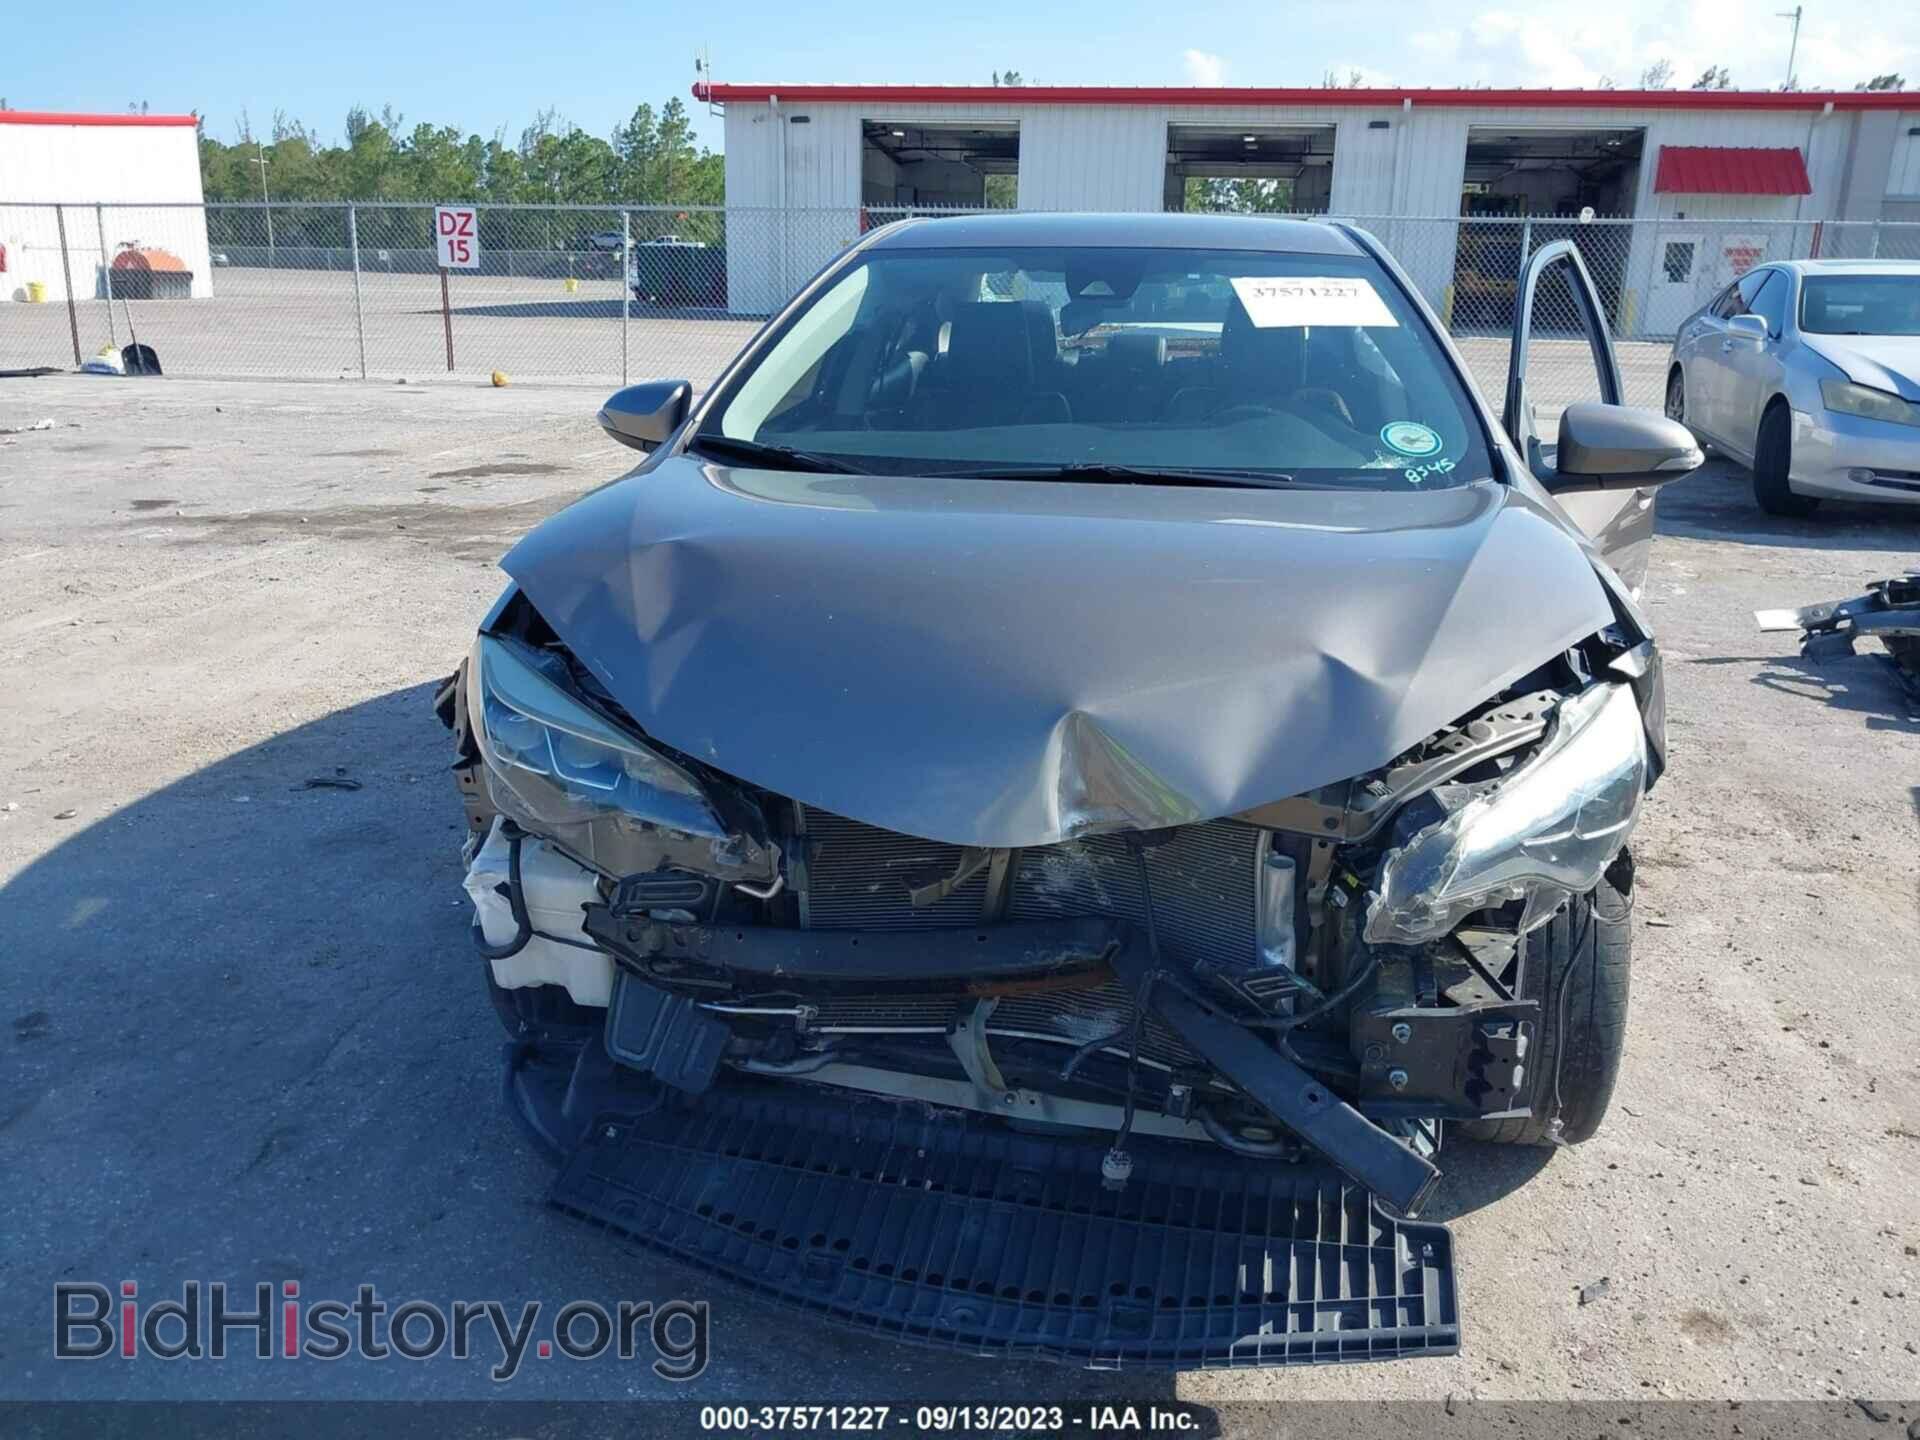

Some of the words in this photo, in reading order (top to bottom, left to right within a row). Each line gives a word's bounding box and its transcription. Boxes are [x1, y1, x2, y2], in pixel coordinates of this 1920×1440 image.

[440, 212, 474, 236] DZ
[448, 239, 470, 262] 15
[1252, 287, 1360, 298] 37571227
